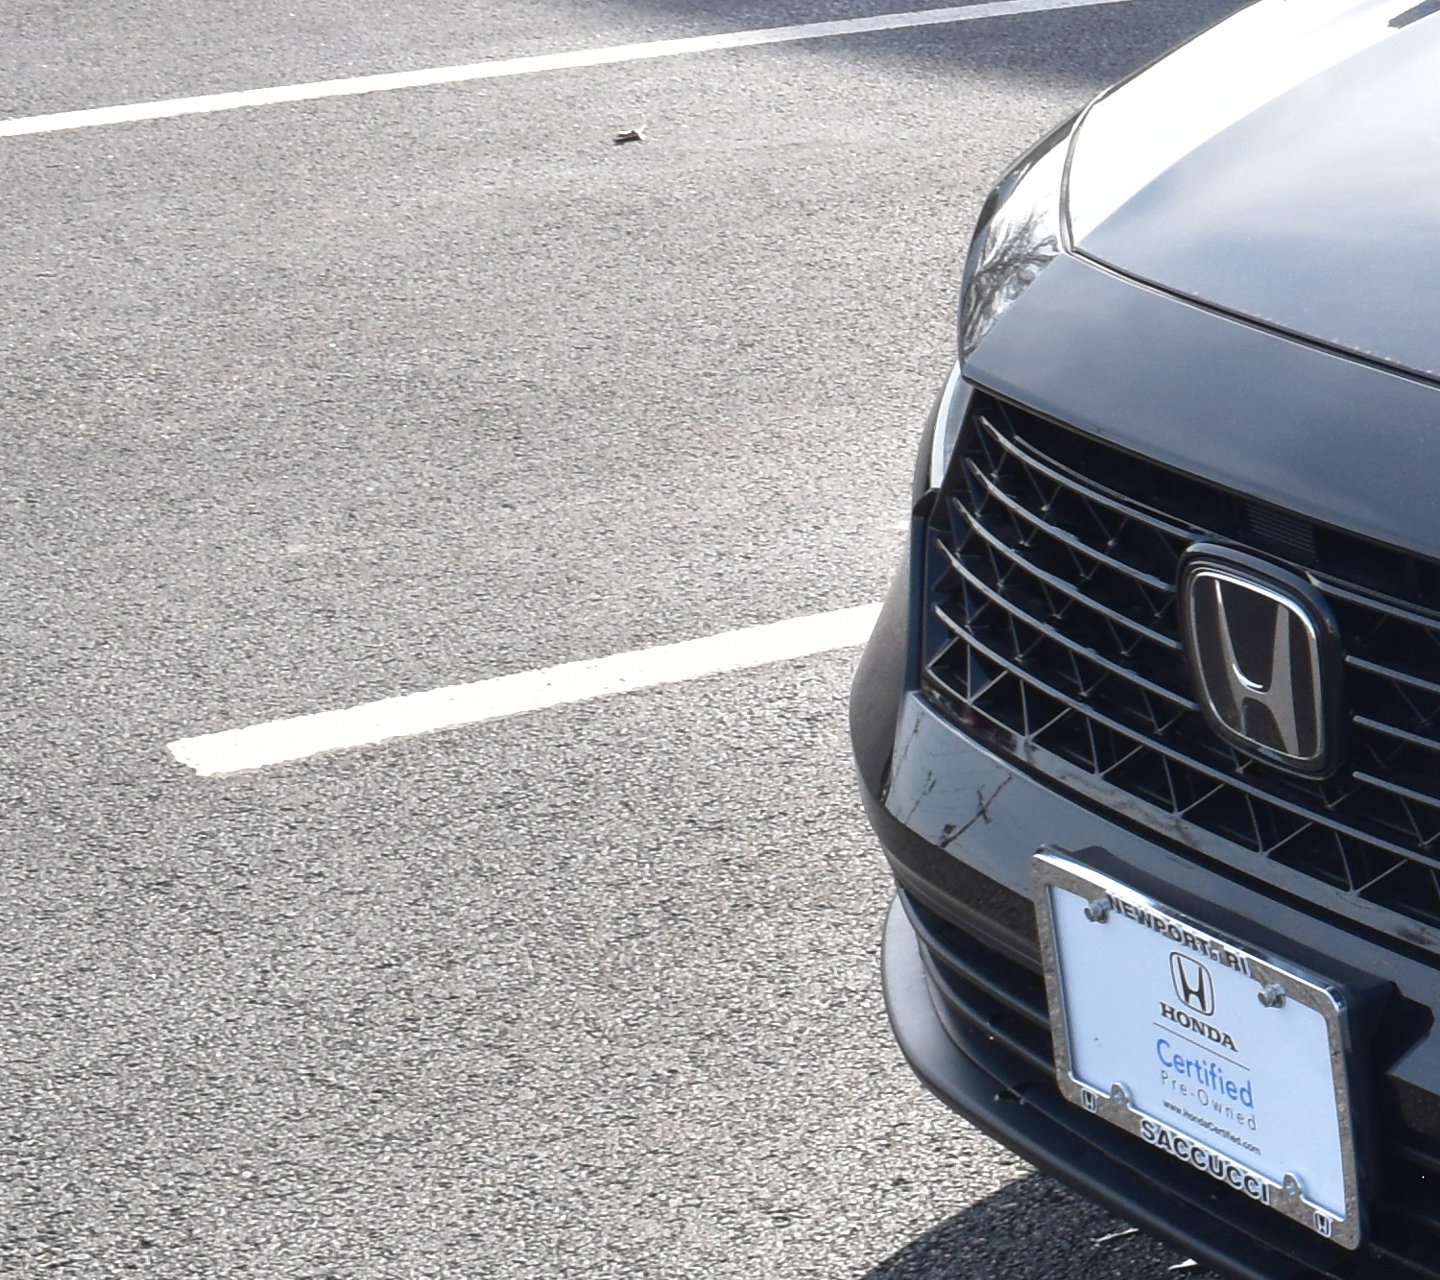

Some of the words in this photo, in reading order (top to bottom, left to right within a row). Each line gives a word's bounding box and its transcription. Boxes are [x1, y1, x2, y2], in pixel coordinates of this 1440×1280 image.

[1227, 951, 1249, 976] RI
[1159, 1001, 1239, 1053] HONDA
[1156, 1038, 1254, 1109] Certified
[1160, 1069, 1257, 1132] Pre-Owned
[1141, 1120, 1269, 1204] SACCUCCI
